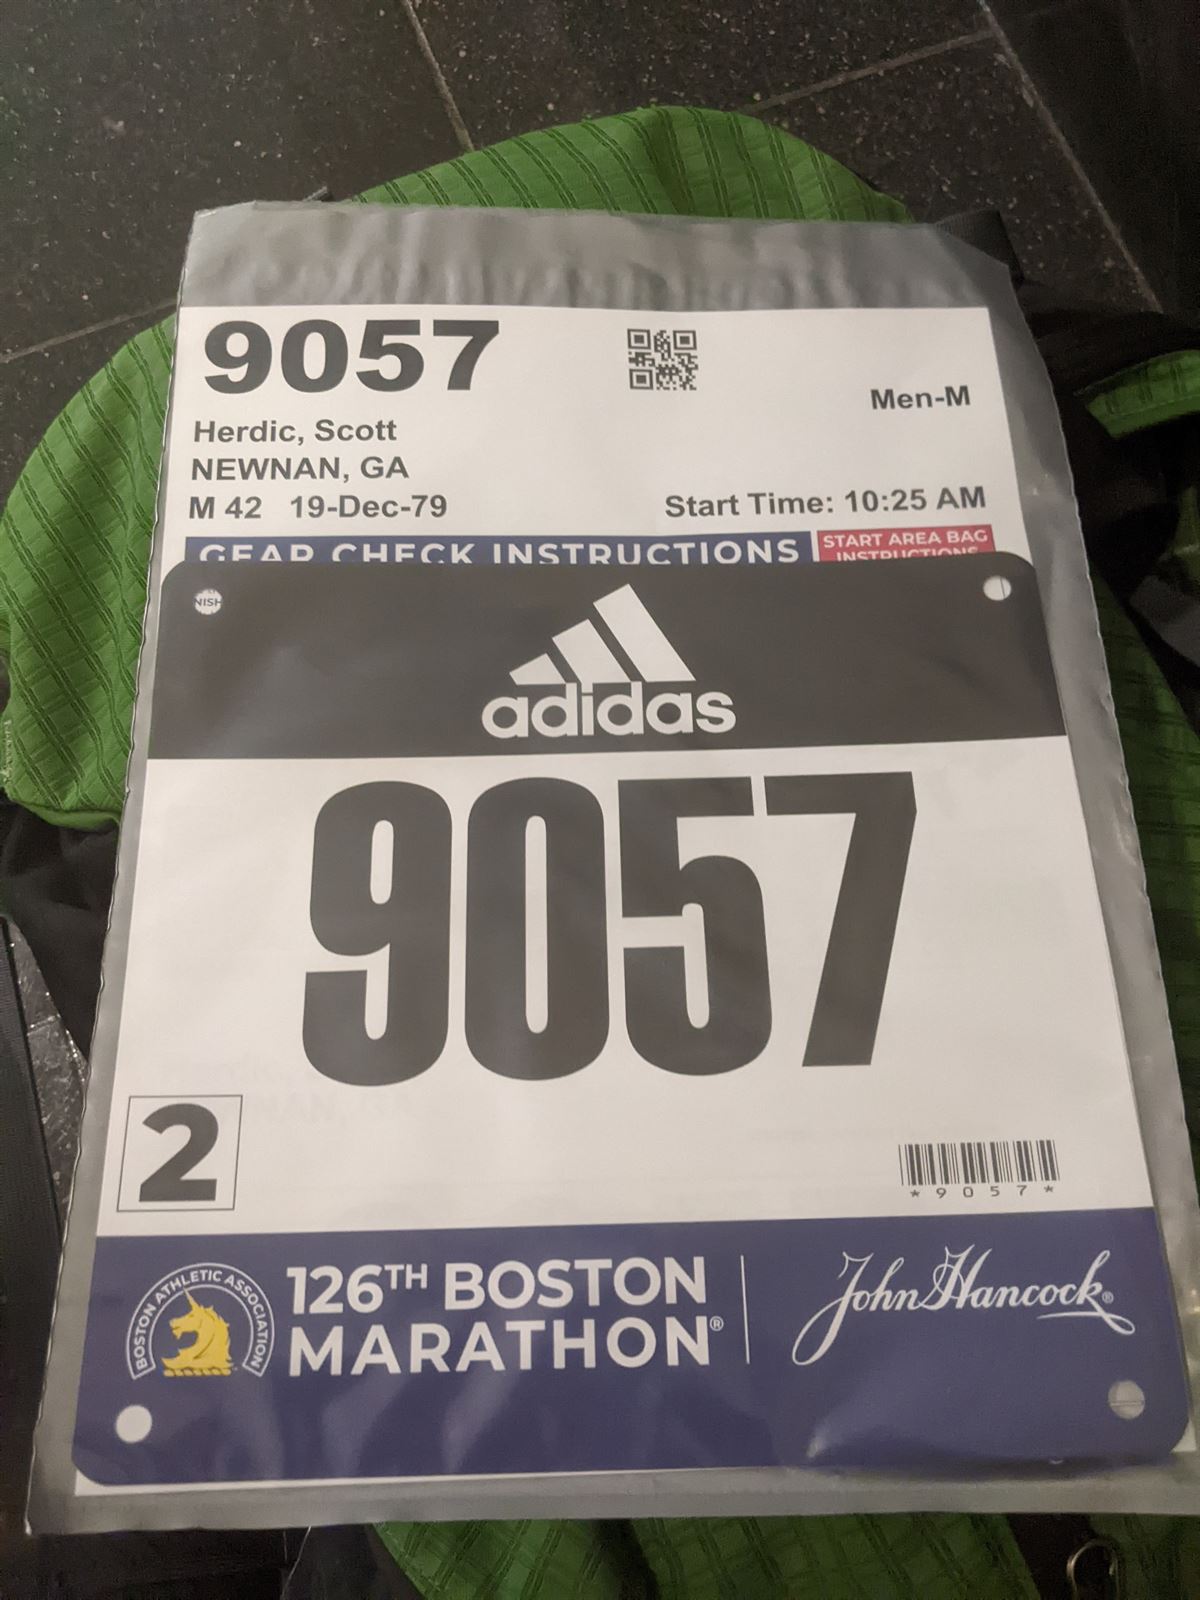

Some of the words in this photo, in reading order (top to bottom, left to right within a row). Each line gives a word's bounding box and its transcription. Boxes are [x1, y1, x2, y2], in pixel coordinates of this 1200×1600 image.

[204, 319, 499, 394] 9057
[870, 386, 970, 410] Men-M
[193, 420, 304, 445] Herdic,
[314, 419, 397, 442] Scott
[191, 457, 350, 483] NEWNAN,
[360, 456, 410, 479] GA
[189, 497, 215, 519] M
[225, 496, 262, 519] 42
[290, 494, 448, 518] 19-Dec-79
[665, 494, 740, 518] Start
[747, 492, 834, 515] Time:
[845, 488, 927, 513] 10:25
[937, 486, 986, 510] AM
[332, 543, 475, 564] CHECK
[493, 539, 800, 565] INSTRUCTIONS
[823, 533, 883, 549] START
[888, 531, 942, 546] AREA
[947, 529, 988, 544] BAG
[481, 681, 736, 739] adidas
[302, 771, 918, 1086] 9057
[138, 1103, 219, 1202] 2
[286, 1263, 428, 1315] 126TH
[444, 1256, 707, 1310] BOSTON
[792, 1250, 921, 1366] John
[133, 1303, 157, 1371] BOSTON
[155, 1269, 223, 1305] ATHLETIC
[224, 1274, 268, 1369] ASSOCIATION
